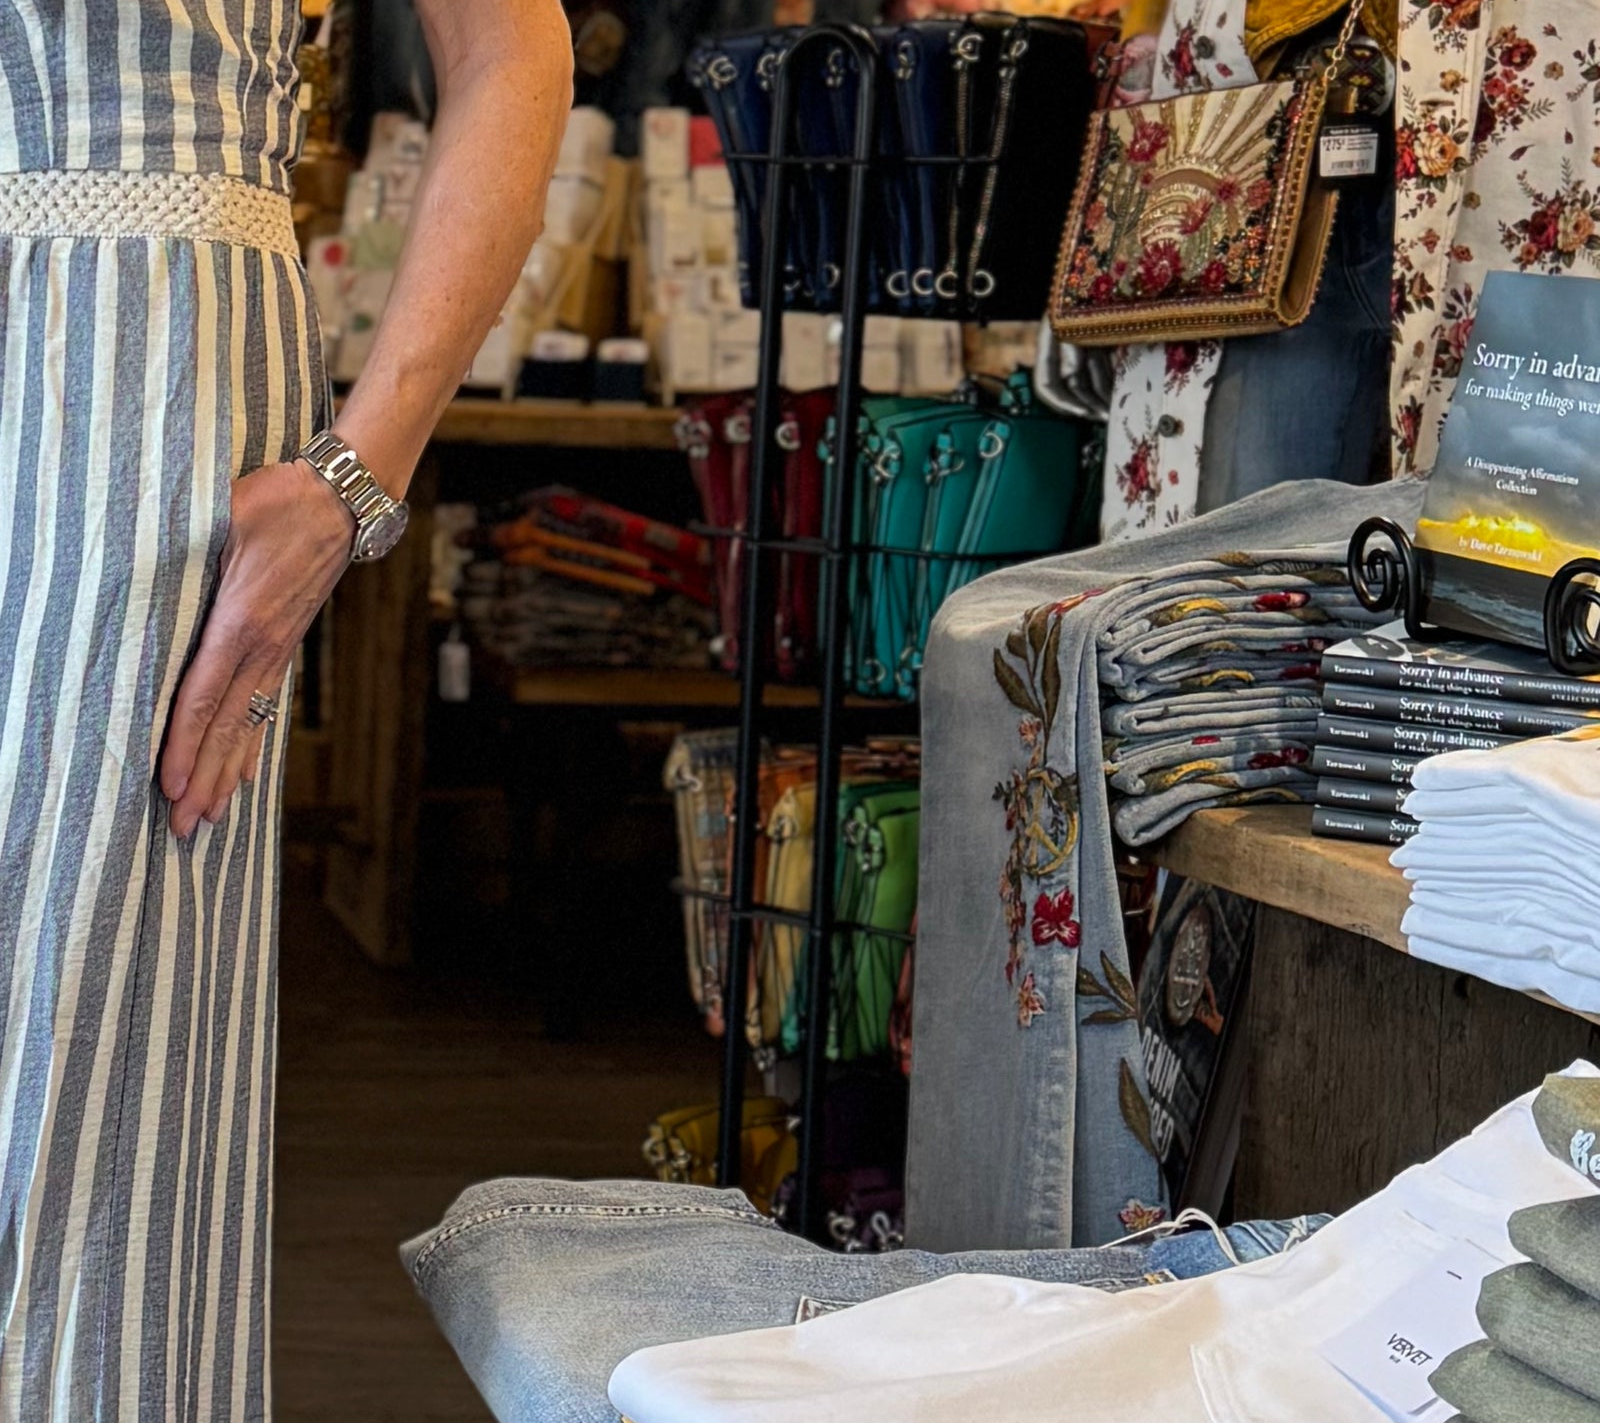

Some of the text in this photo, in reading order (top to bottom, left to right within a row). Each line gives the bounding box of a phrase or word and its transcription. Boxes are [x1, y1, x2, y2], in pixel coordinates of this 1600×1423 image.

[1473, 343, 1525, 380] Sorry
[1528, 351, 1548, 375] in
[1465, 378, 1484, 396] for
[1486, 382, 1533, 411] making
[1535, 388, 1574, 417] things
[1464, 456, 1579, 486] A Disappointing Affirmations
[1495, 478, 1538, 496] Collection
[1469, 538, 1493, 552] Dave
[1494, 542, 1542, 563] Tarnowski
[1334, 663, 1504, 685] Tarnowski Sorry in advance
[1399, 678, 1412, 687] for
[1414, 680, 1445, 693] making
[1446, 682, 1473, 695] things
[1335, 696, 1504, 720] Tarnowski Sorry in advance
[1414, 715, 1446, 726] making
[1329, 725, 1499, 749] Tarnowski Sorry in advance
[1325, 758, 1366, 772] Tarnowski
[1330, 789, 1370, 801] Tarnowski
[1325, 819, 1364, 832] Tarnowski
[1387, 1333, 1433, 1366] VERVET
